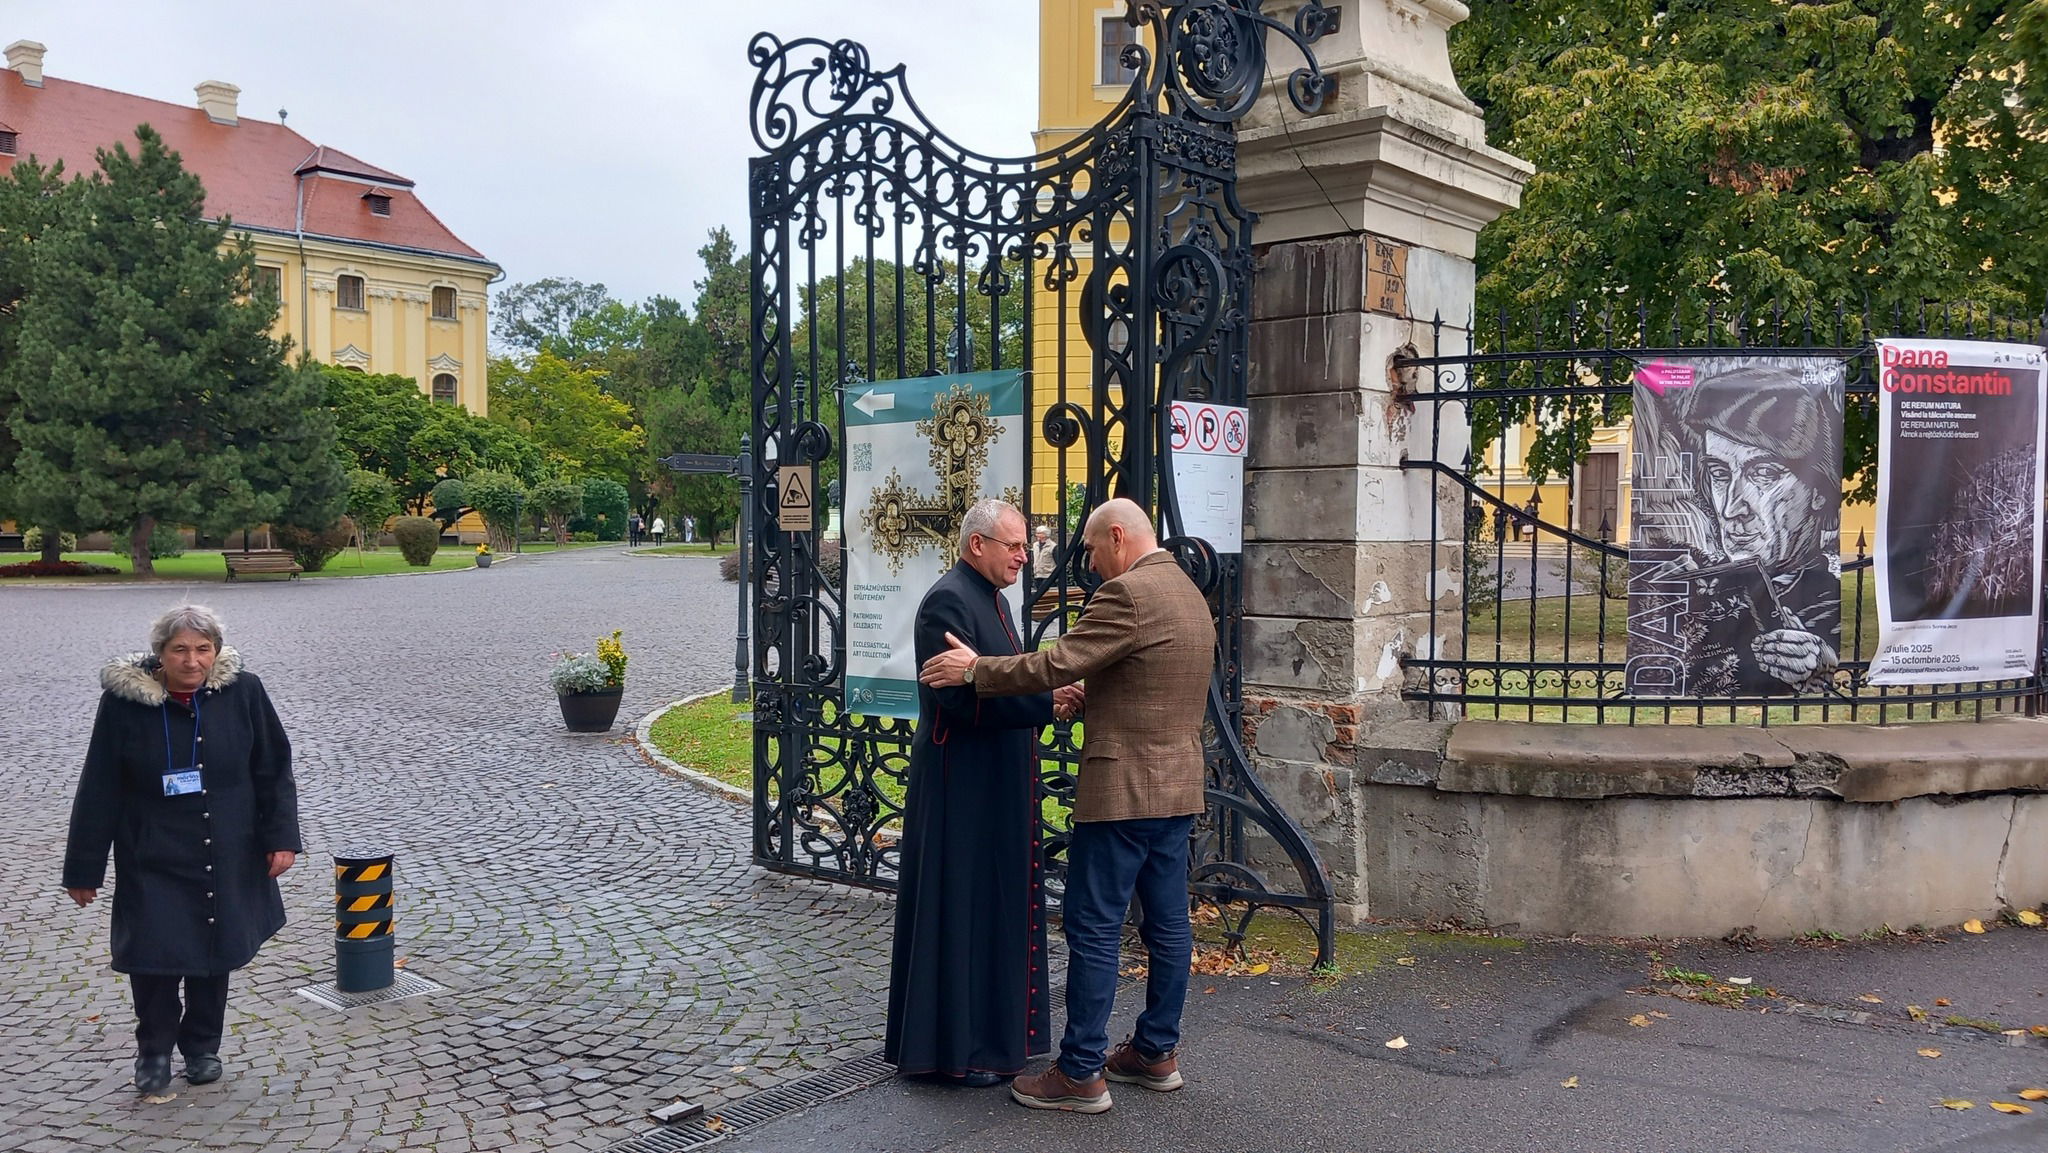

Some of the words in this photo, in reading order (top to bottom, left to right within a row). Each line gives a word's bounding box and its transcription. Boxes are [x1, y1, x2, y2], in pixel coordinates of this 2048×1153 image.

[1883, 345, 1948, 369] Dana
[1883, 369, 2013, 396] Constantin
[1901, 401, 1910, 409] DE
[1911, 401, 1934, 409] RERUM
[1911, 421, 1933, 429] RERUM
[1934, 421, 1959, 429] NATURA
[1624, 452, 1693, 697] DANTE
[853, 612, 882, 620] PATRIMONIU
[852, 641, 890, 649] ECCLESIASTICAL
[1893, 644, 1909, 653] iulie
[1910, 644, 1932, 653] 2025
[862, 651, 891, 659] COLLECTION
[1891, 656, 1900, 665] 15
[1902, 655, 1941, 664] octombrie
[1942, 654, 1960, 664] 2025
